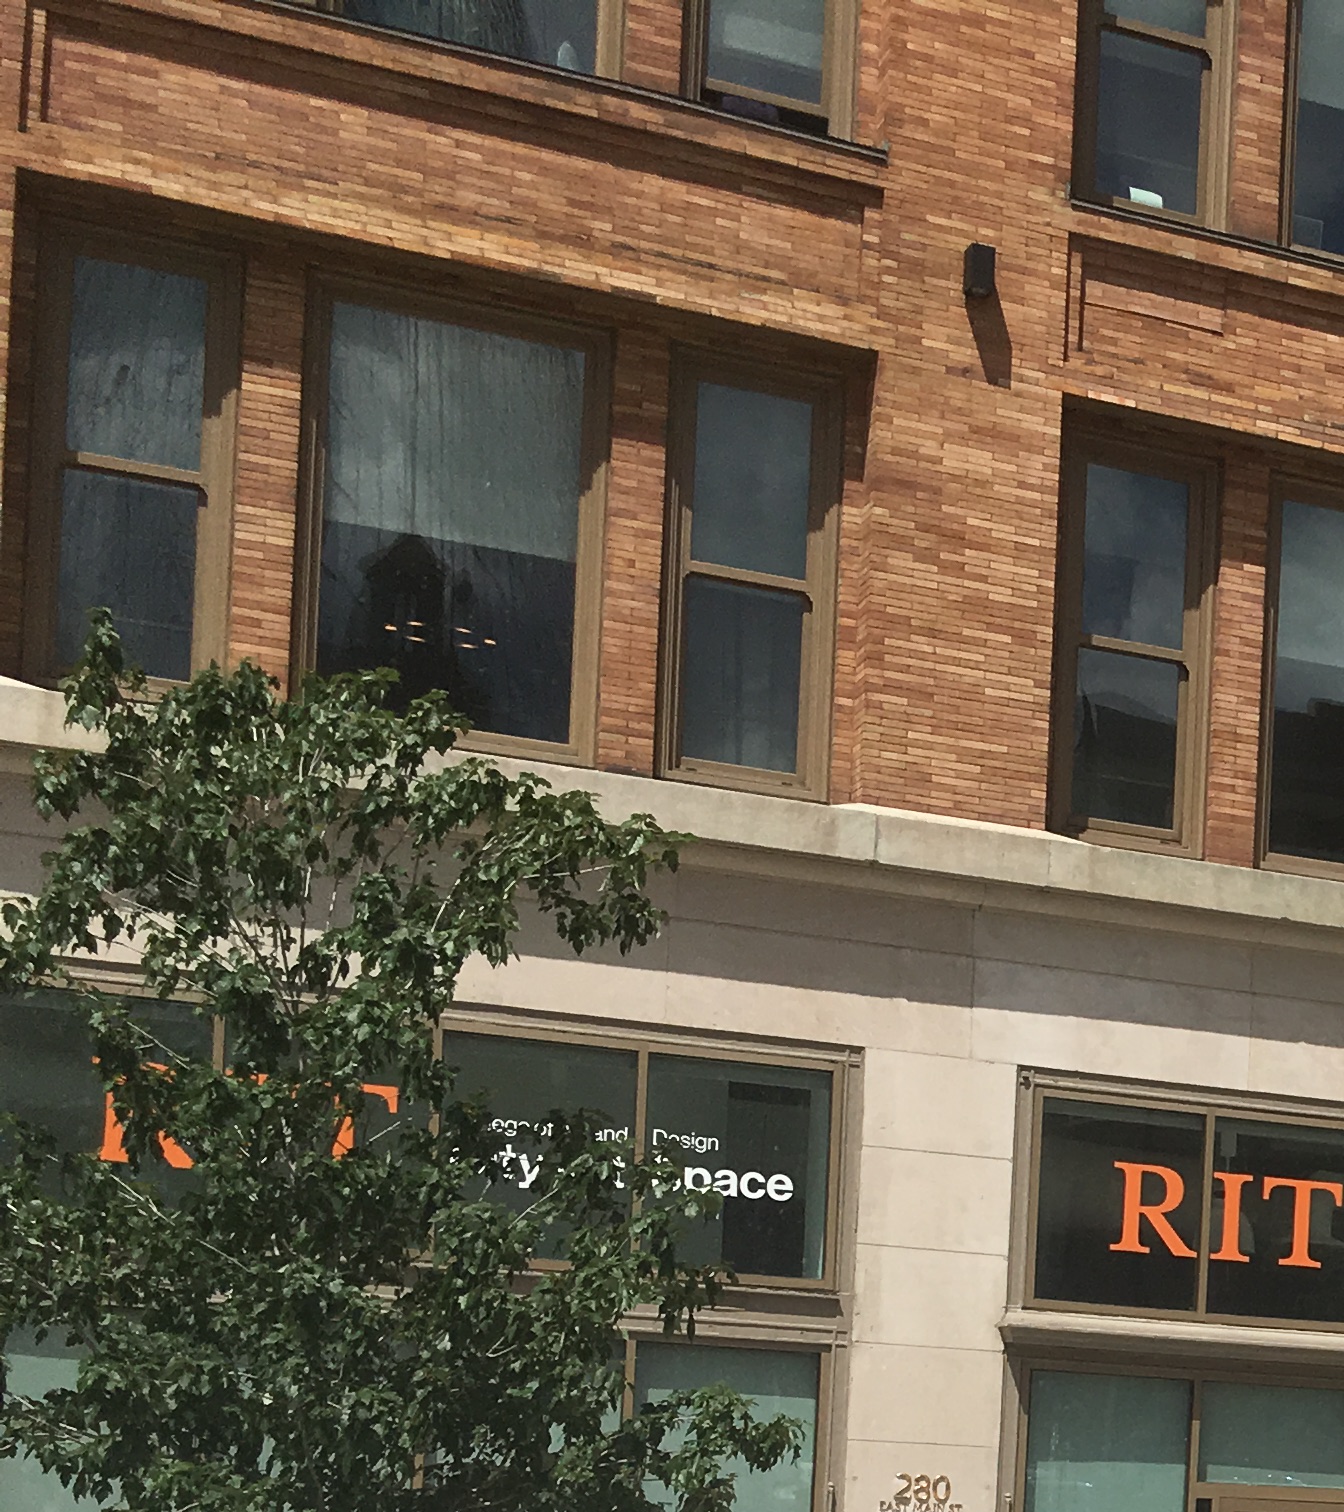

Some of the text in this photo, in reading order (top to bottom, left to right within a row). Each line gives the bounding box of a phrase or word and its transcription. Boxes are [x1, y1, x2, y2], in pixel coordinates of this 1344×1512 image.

[652, 1154, 795, 1202] pace
[1109, 1160, 1344, 1270] RIT
[893, 1472, 951, 1505] 280
